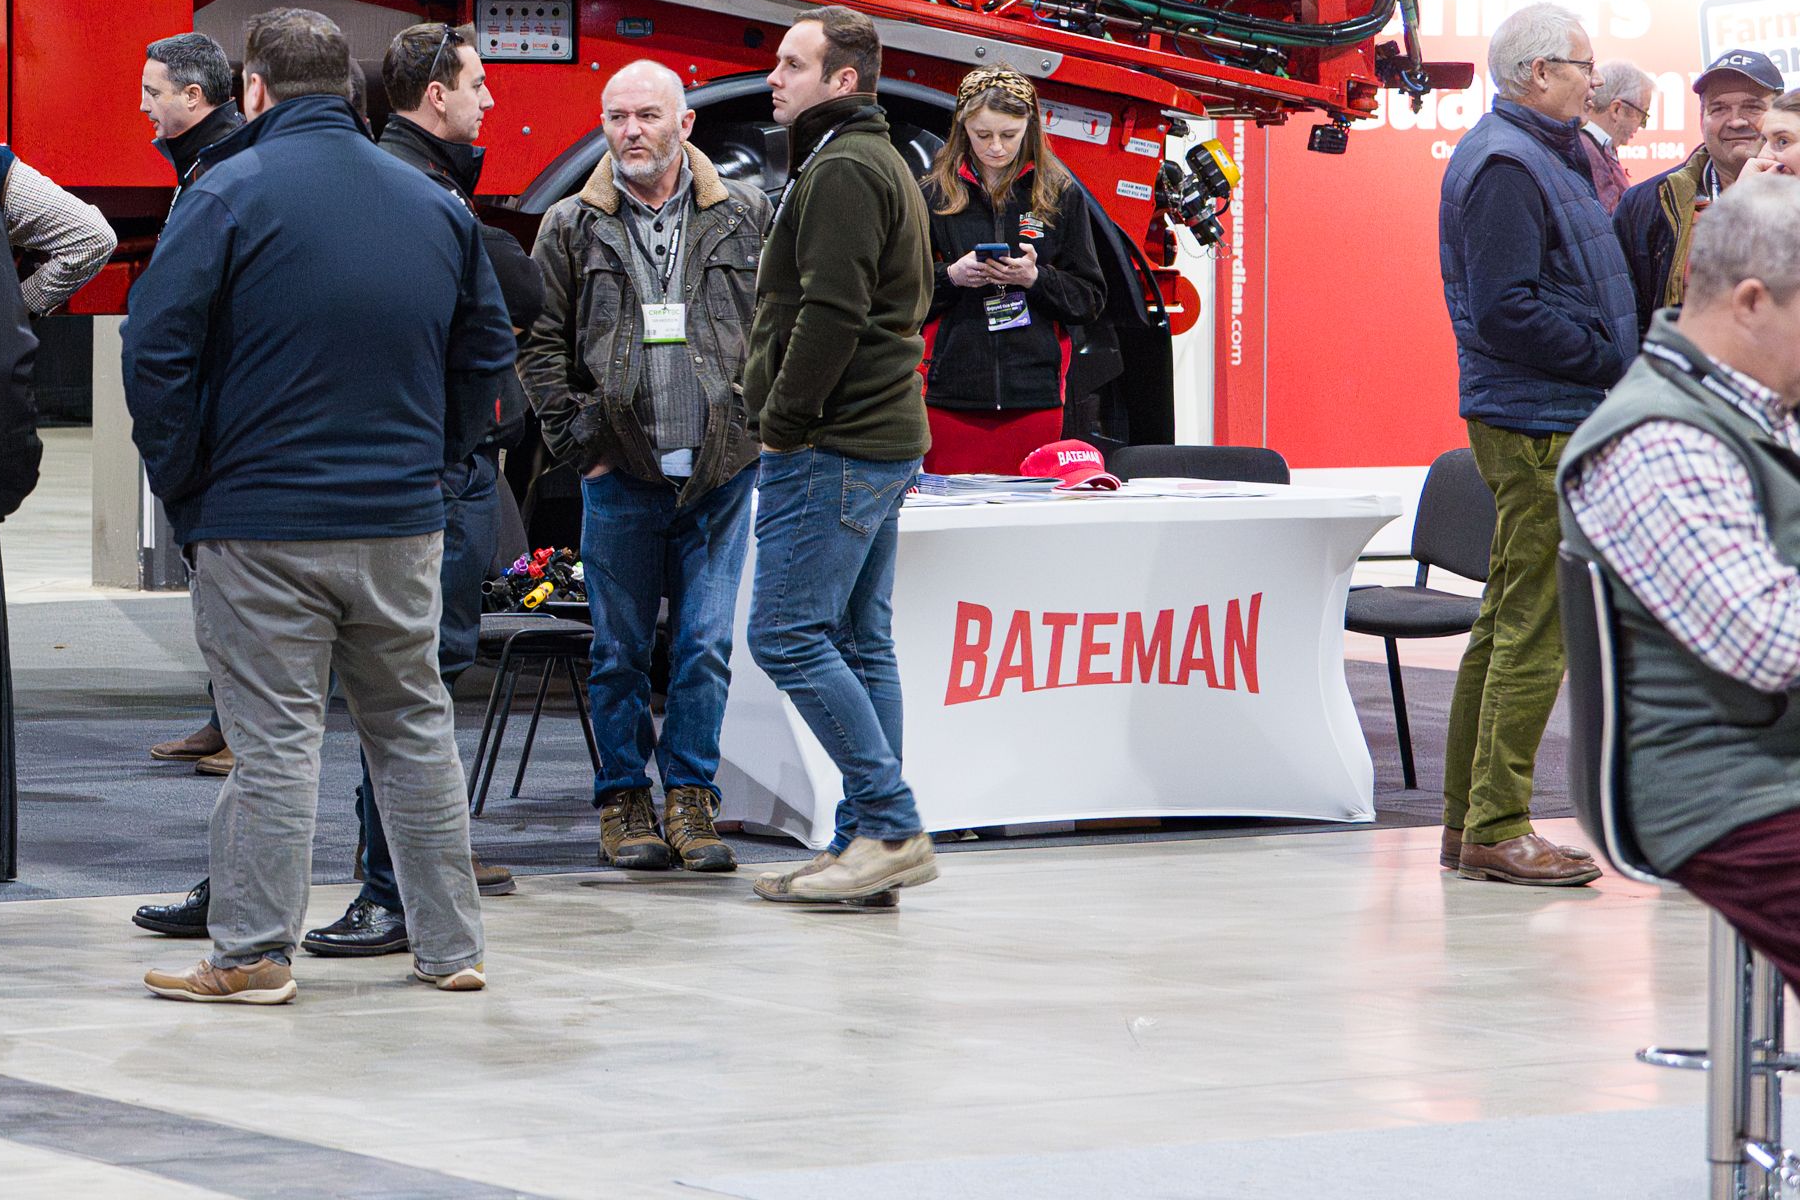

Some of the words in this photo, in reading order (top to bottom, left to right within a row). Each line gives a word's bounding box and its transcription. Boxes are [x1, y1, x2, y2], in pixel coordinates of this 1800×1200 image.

[1649, 142, 1686, 160] 1884
[1057, 450, 1102, 467] BATEMAN
[943, 592, 1264, 707] BATEMAN
